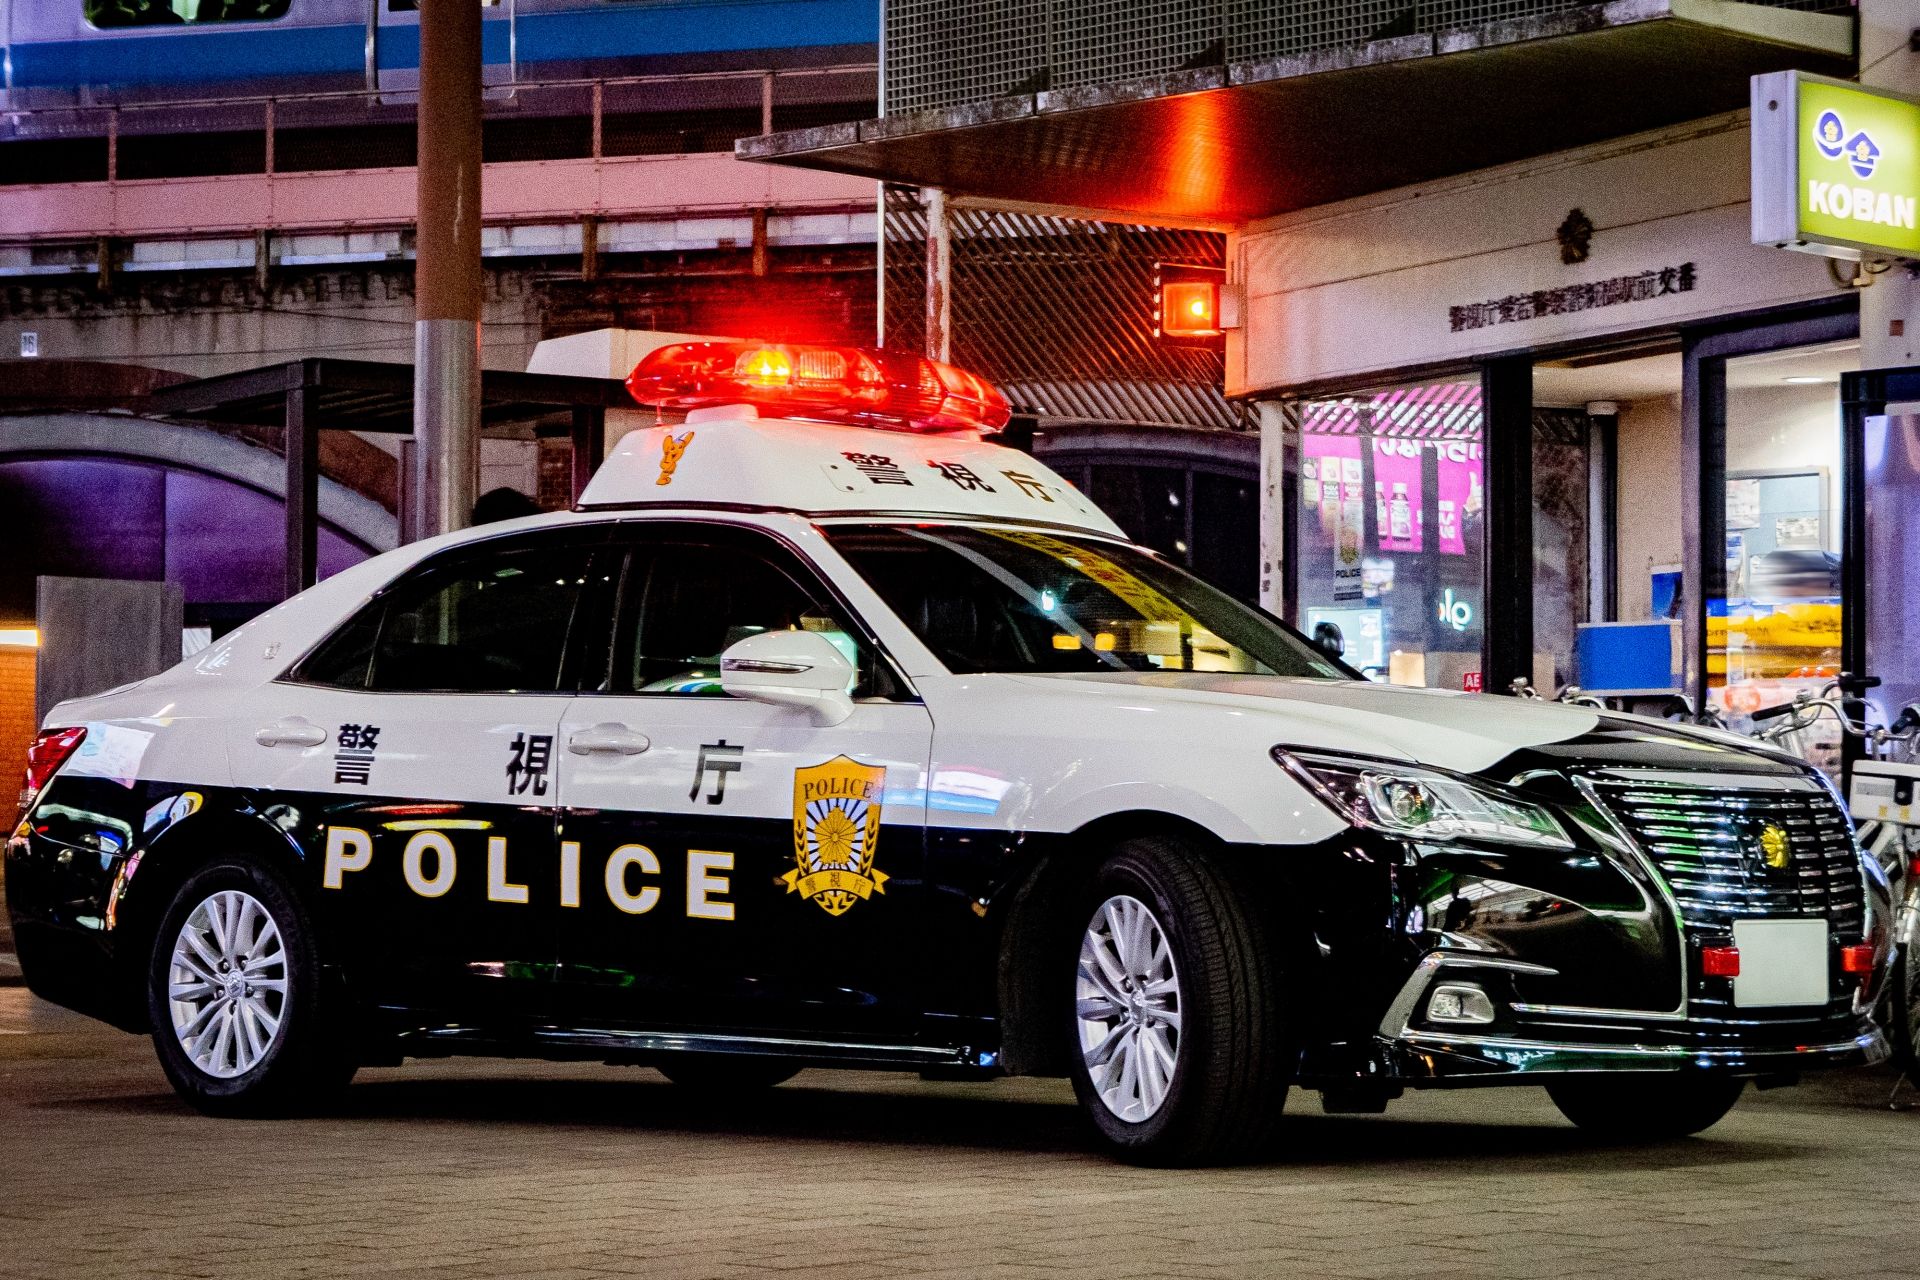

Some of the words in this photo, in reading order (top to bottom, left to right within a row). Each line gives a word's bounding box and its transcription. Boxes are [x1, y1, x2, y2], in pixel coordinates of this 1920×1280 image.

[1808, 179, 1916, 229] KOBAN
[841, 451, 1054, 503] 警視庁
[1335, 568, 1361, 579] POLICE
[1464, 674, 1481, 688] AE
[334, 723, 744, 805] 警視庁
[803, 777, 873, 800] POLICE
[322, 826, 737, 921] POLICE
[805, 871, 867, 895] 警視庁
